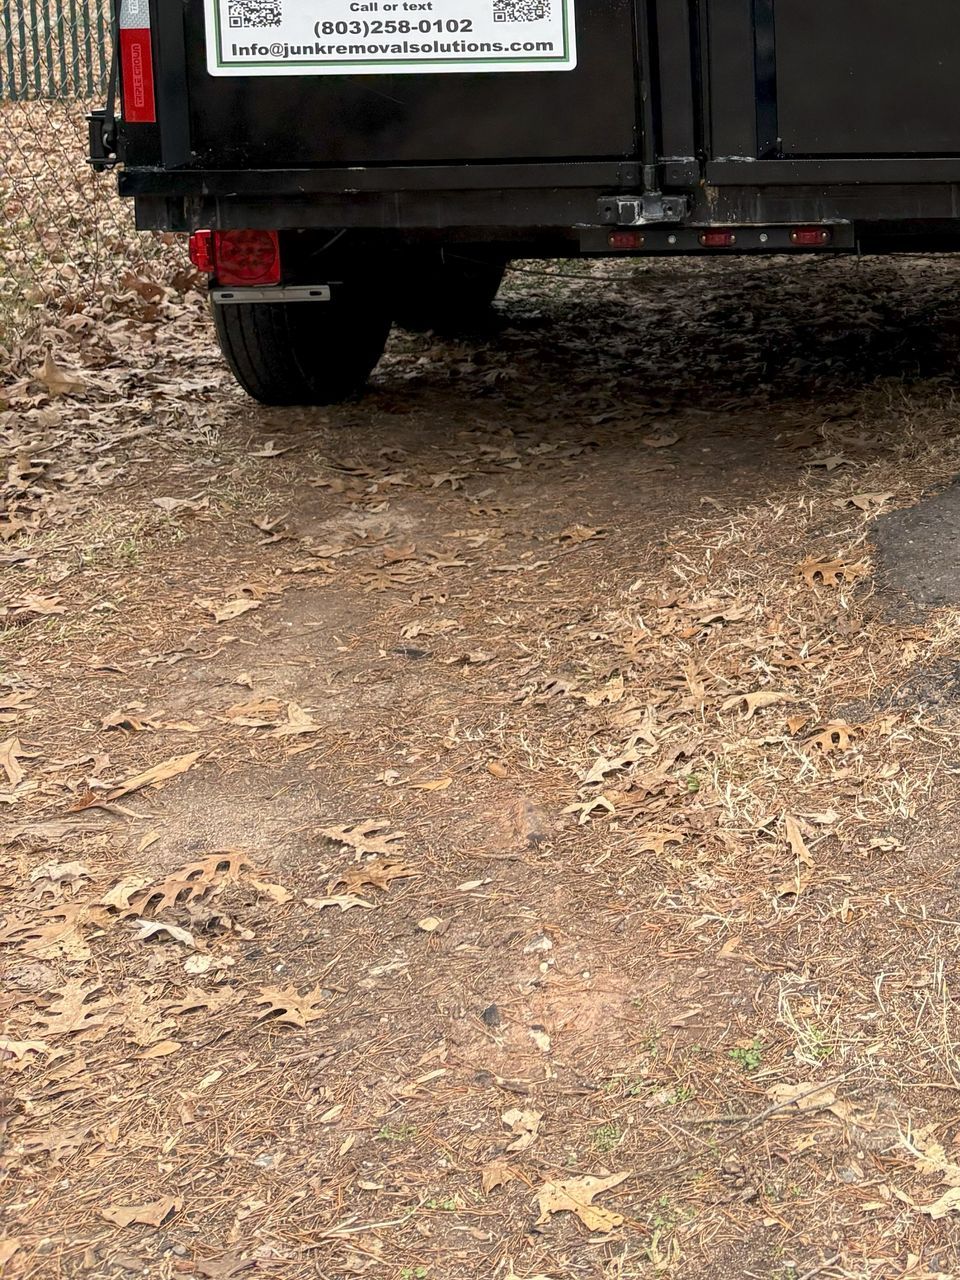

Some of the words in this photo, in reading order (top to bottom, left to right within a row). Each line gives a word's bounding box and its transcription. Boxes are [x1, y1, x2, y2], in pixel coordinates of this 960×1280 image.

[350, 2, 378, 12] Call
[383, 4, 398, 12] or
[402, 1, 433, 11] text
[313, 19, 473, 38] (803)258-0102
[231, 40, 554, 58] Info@junkremovalsolutions.com
